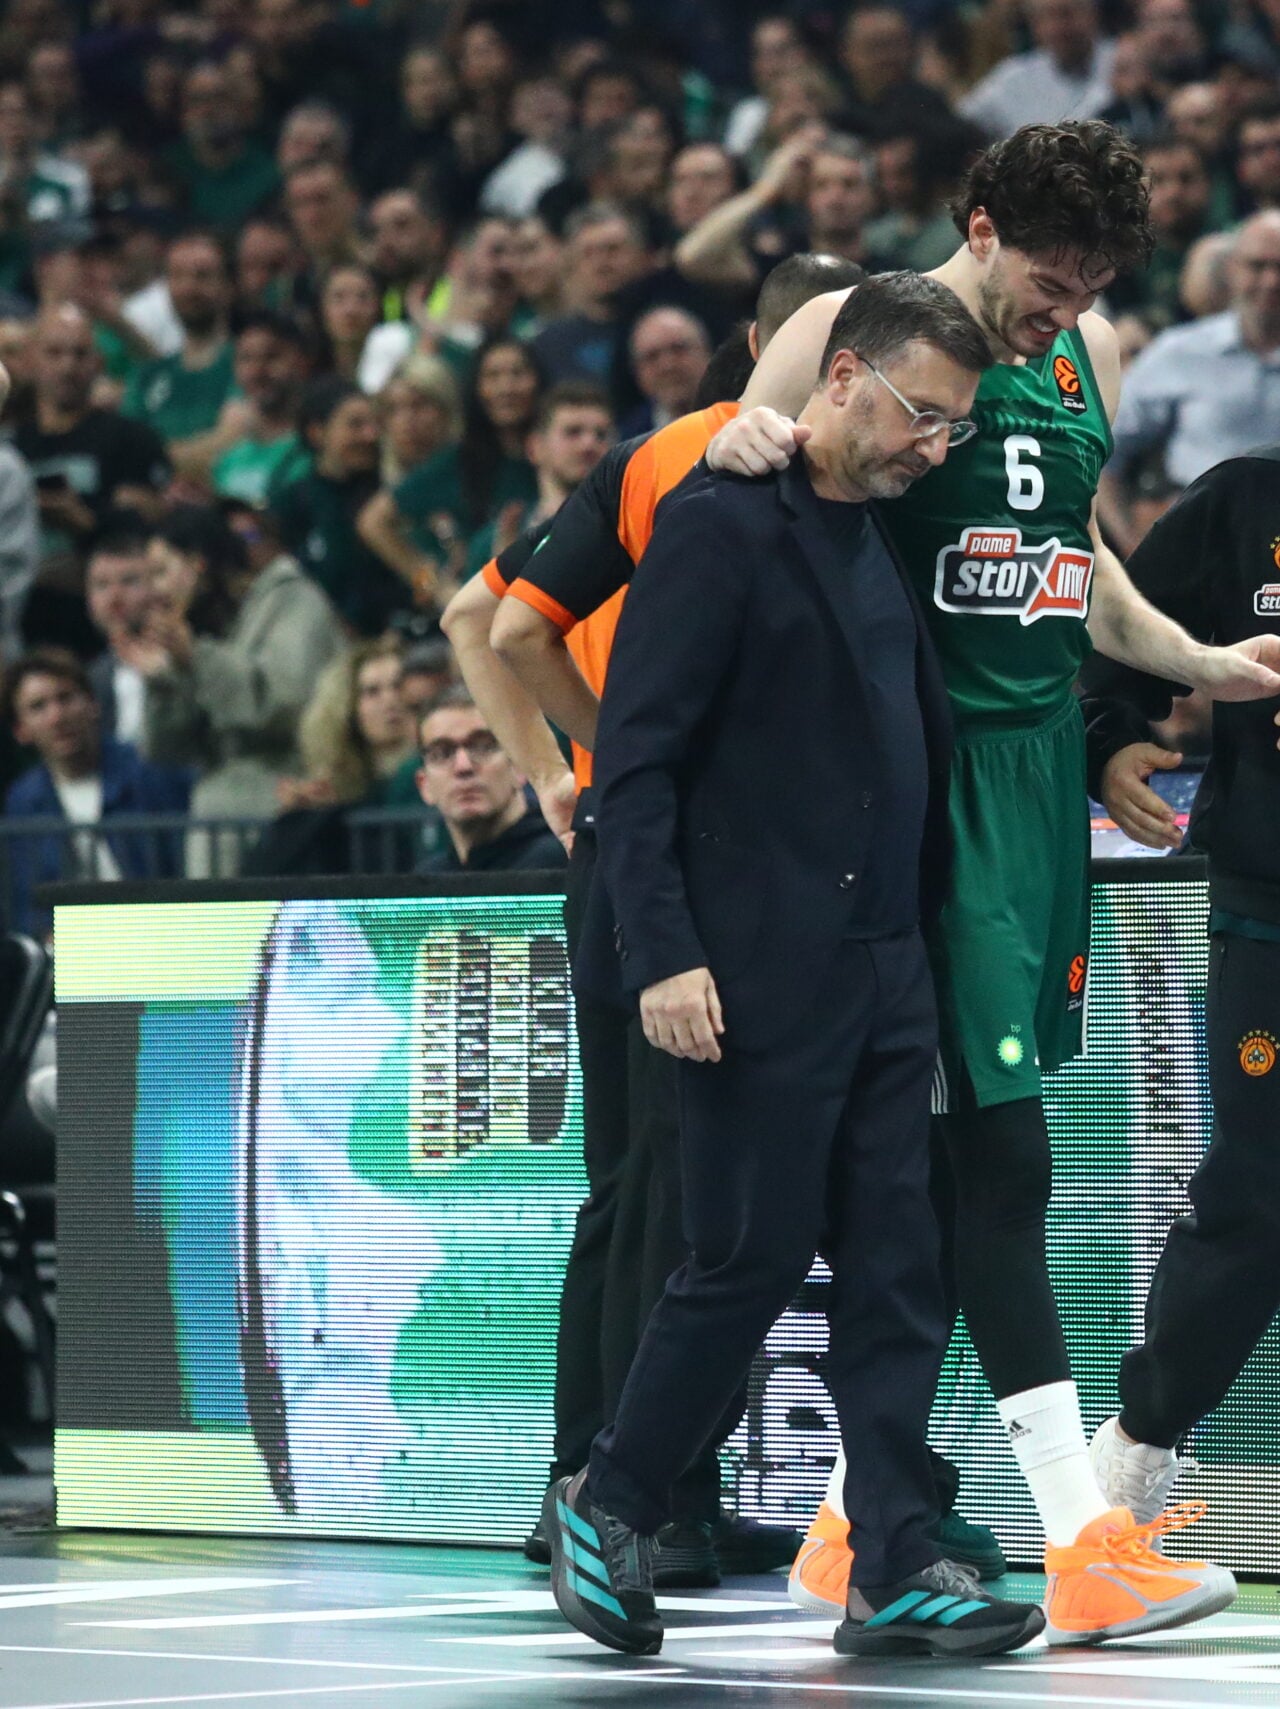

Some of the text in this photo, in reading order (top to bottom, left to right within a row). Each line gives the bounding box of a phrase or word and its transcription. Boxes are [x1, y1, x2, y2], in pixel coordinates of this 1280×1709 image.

[1004, 434, 1045, 511] 6
[970, 537, 1012, 554] pame
[1010, 1023, 1021, 1034] bp
